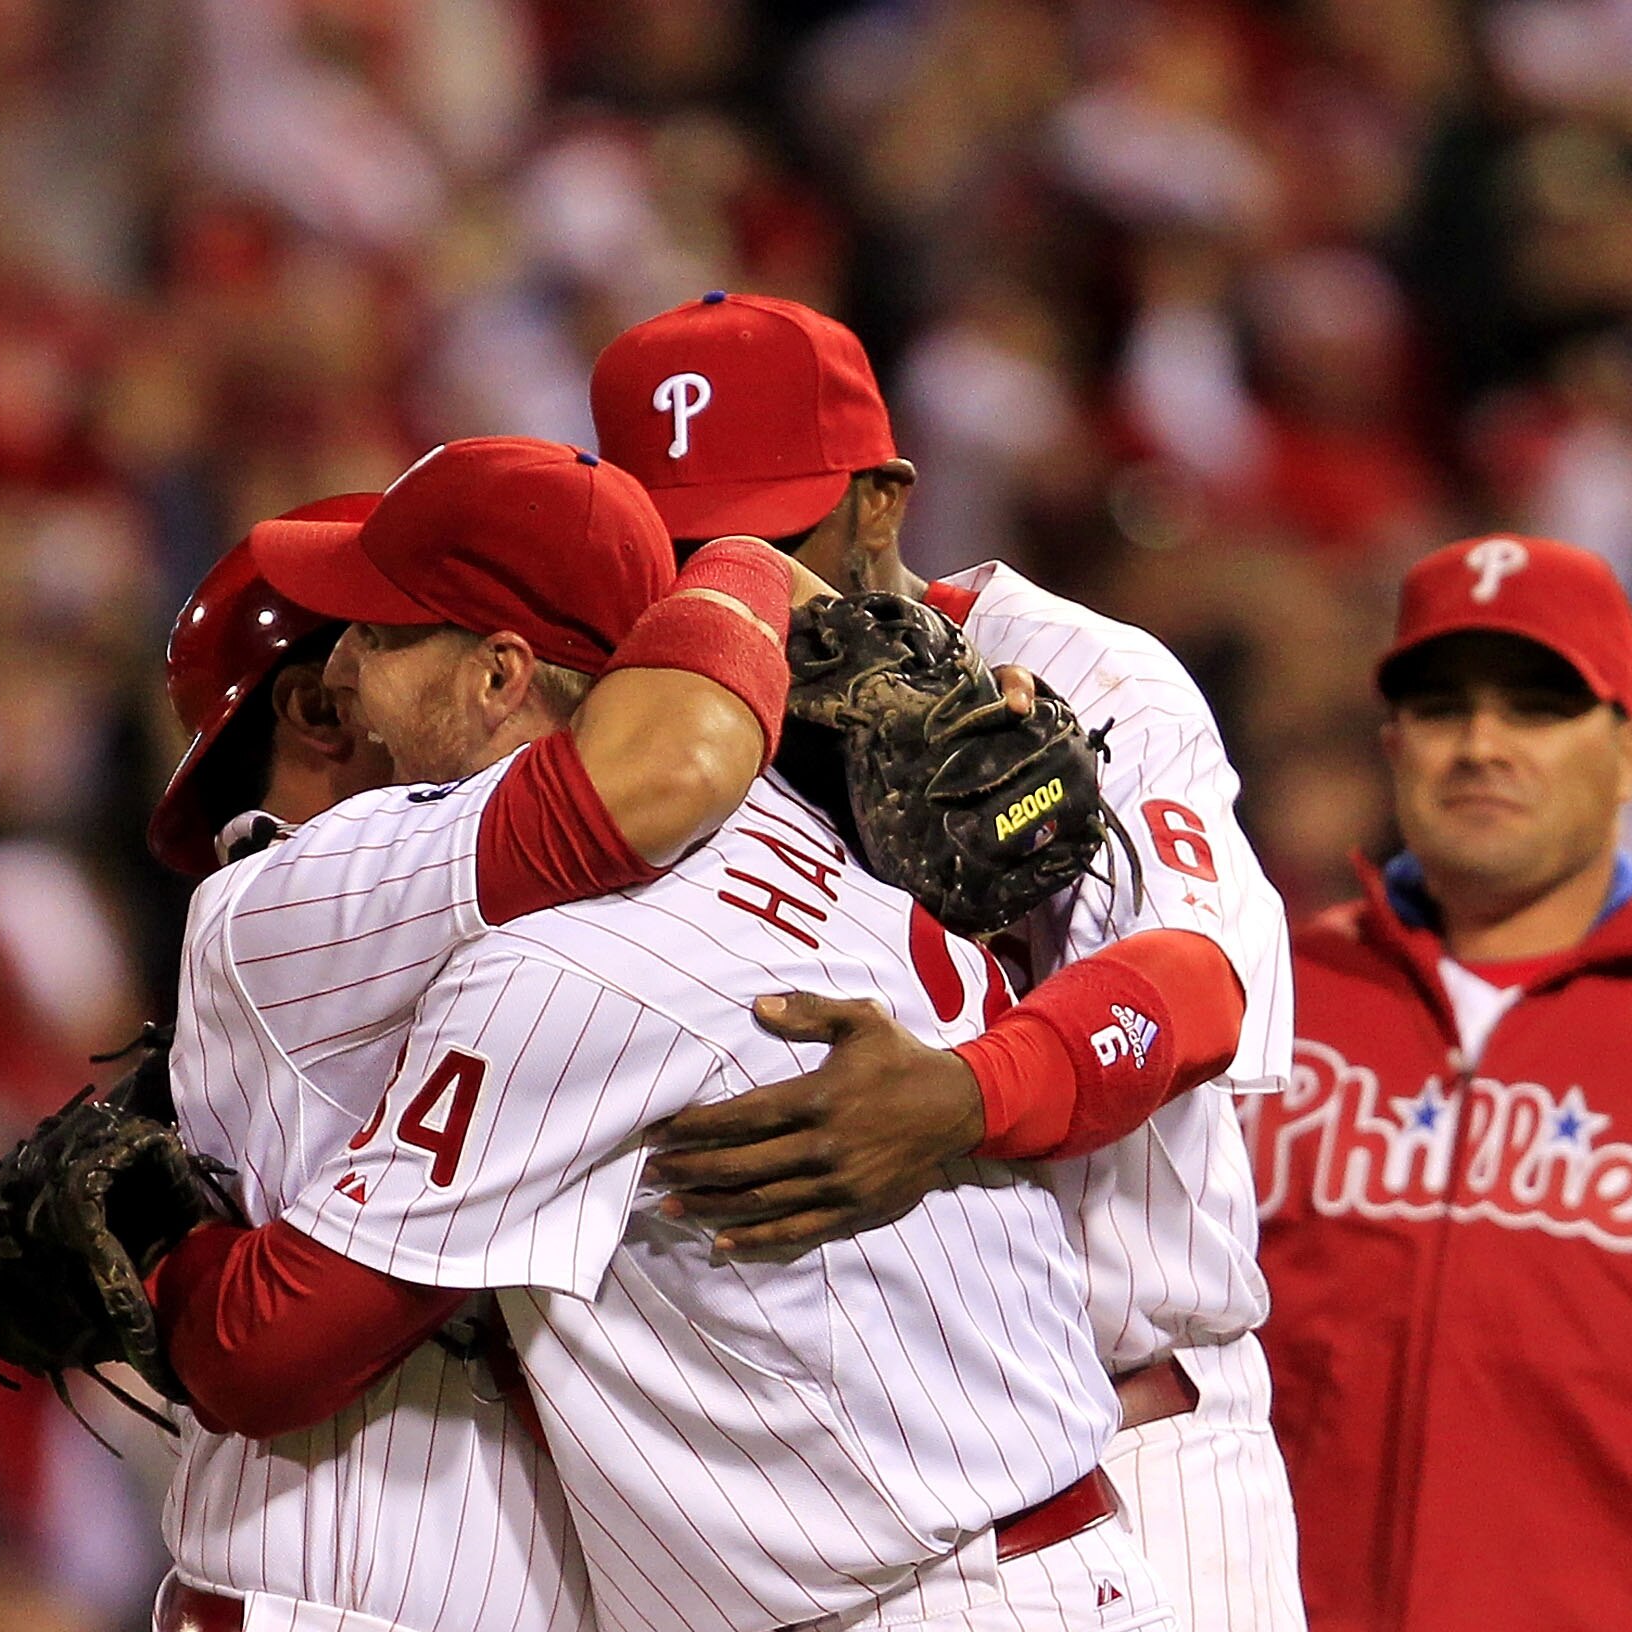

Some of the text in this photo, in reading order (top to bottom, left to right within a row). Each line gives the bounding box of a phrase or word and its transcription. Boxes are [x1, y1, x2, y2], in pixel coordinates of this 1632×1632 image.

[653, 373, 712, 459] P
[1466, 539, 1529, 602] P
[993, 777, 1064, 842] A2000
[1141, 798, 1218, 883] 6
[1090, 1024, 1130, 1067] 6
[1111, 1004, 1145, 1069] adidas
